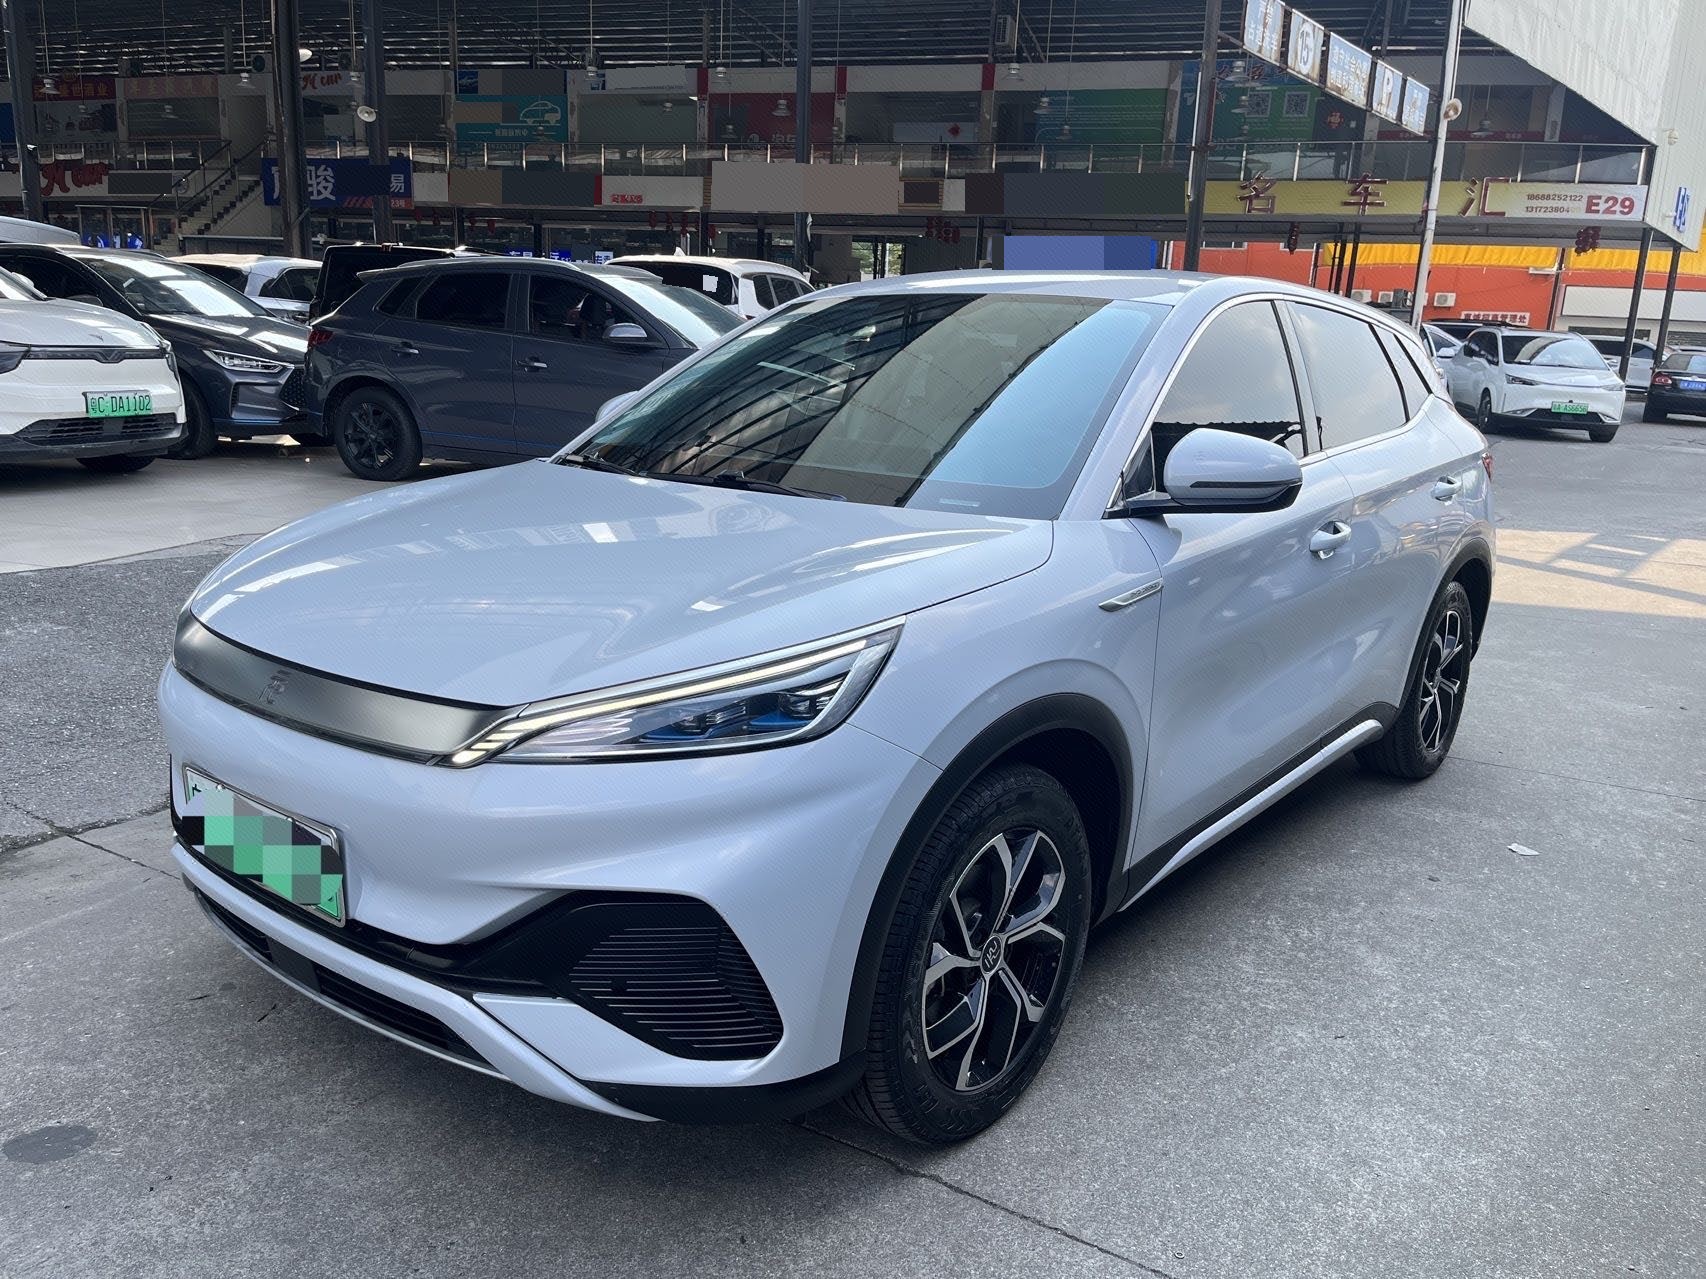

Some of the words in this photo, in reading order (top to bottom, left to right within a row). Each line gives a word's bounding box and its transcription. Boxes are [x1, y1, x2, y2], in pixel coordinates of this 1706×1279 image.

[1299, 29, 1311, 65] 15
[1237, 171, 1512, 217] 名车汇
[1584, 194, 1636, 216] E29
[110, 394, 151, 413] DA1102
